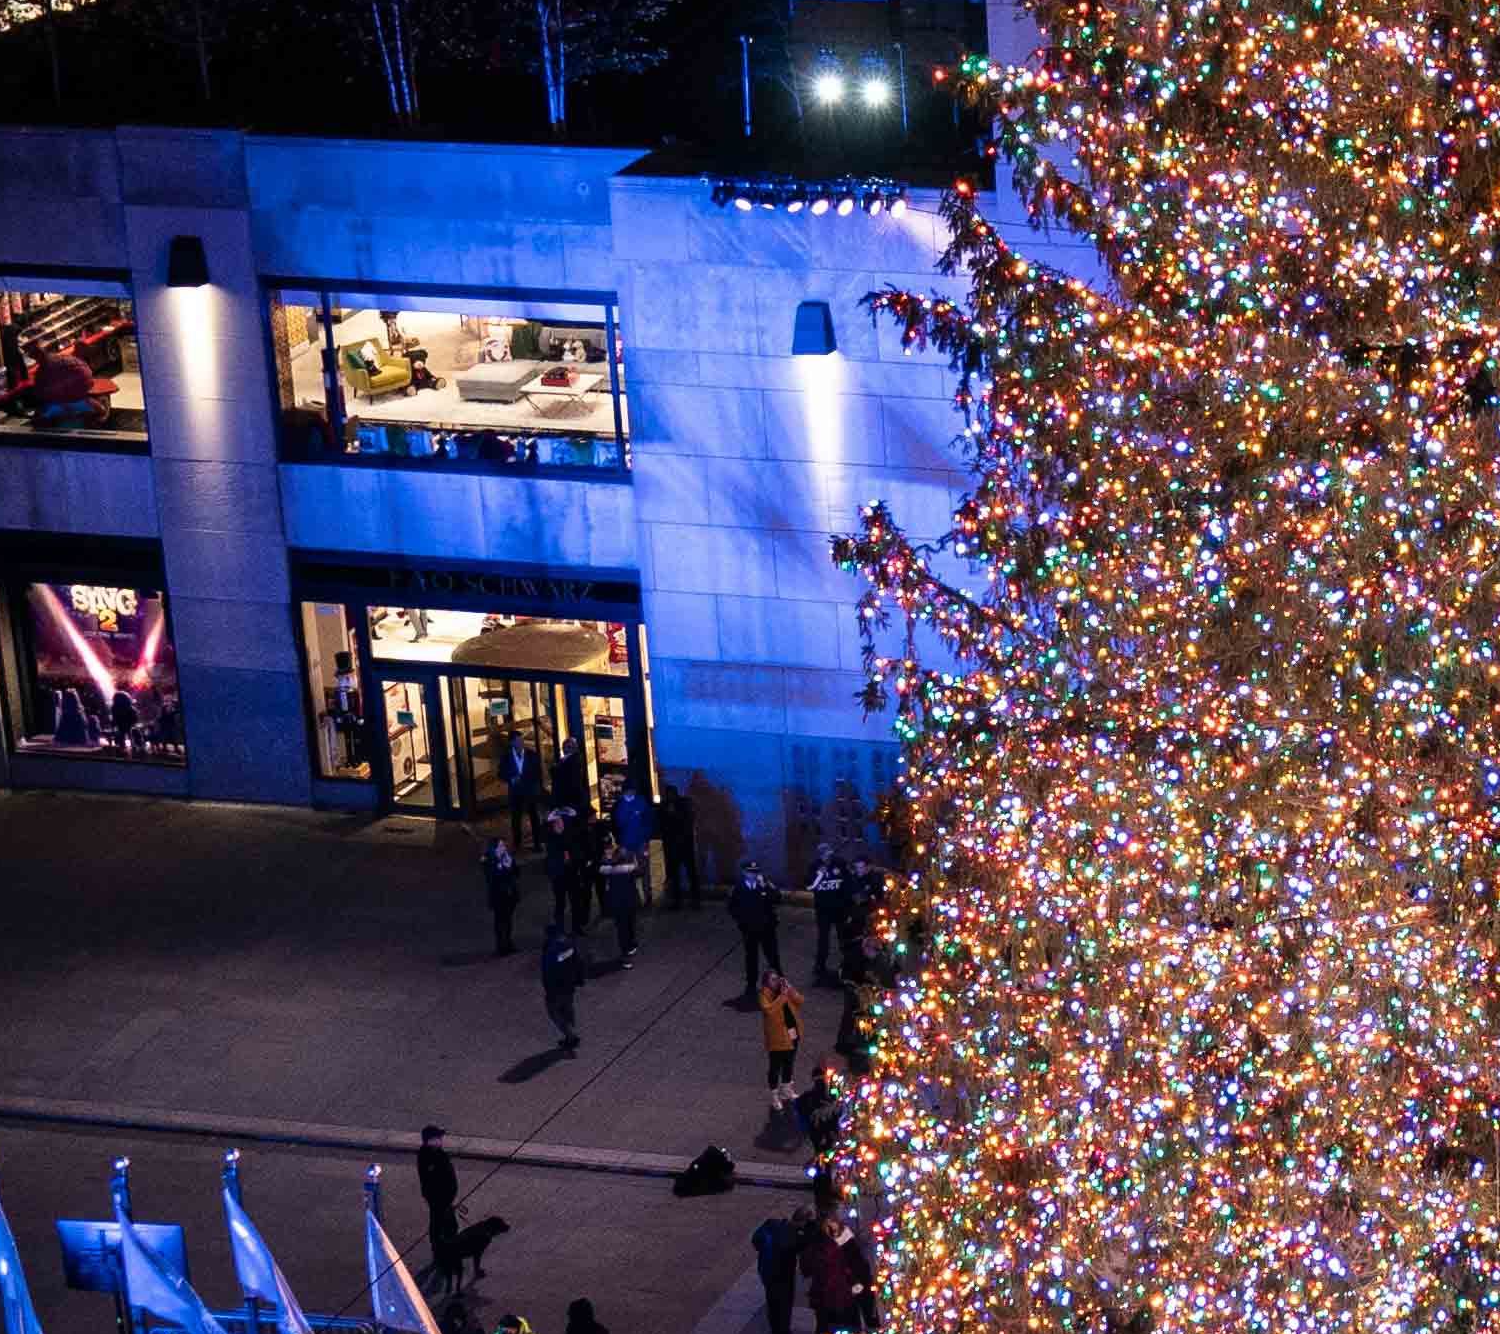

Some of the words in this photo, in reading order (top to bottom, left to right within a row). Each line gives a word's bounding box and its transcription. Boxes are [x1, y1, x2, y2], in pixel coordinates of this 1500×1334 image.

[70, 584, 138, 617] SING
[466, 575, 595, 605] SCHWARZ
[98, 608, 119, 632] 2
